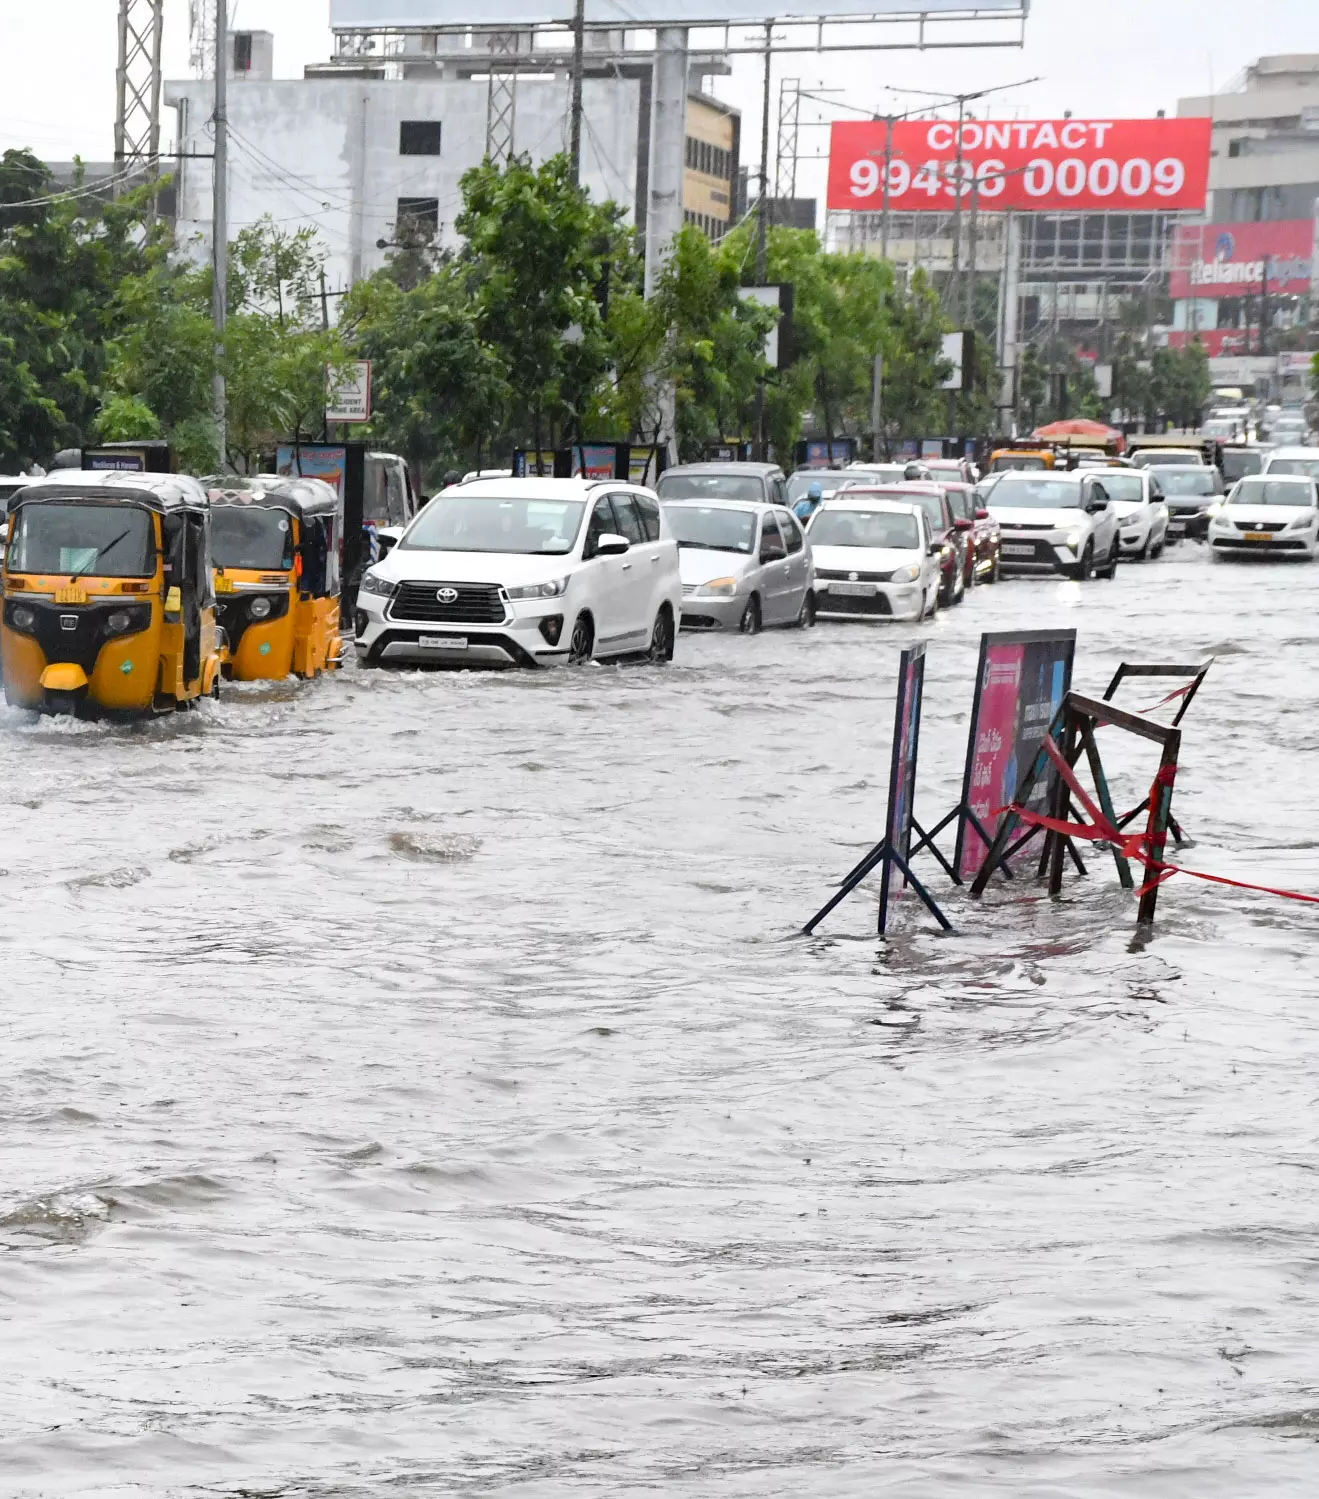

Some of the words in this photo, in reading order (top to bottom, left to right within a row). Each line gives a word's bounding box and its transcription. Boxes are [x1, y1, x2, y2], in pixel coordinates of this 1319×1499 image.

[927, 122, 1113, 150] CONTACT
[849, 158, 1006, 198] 99496
[1023, 156, 1185, 197] 00009
